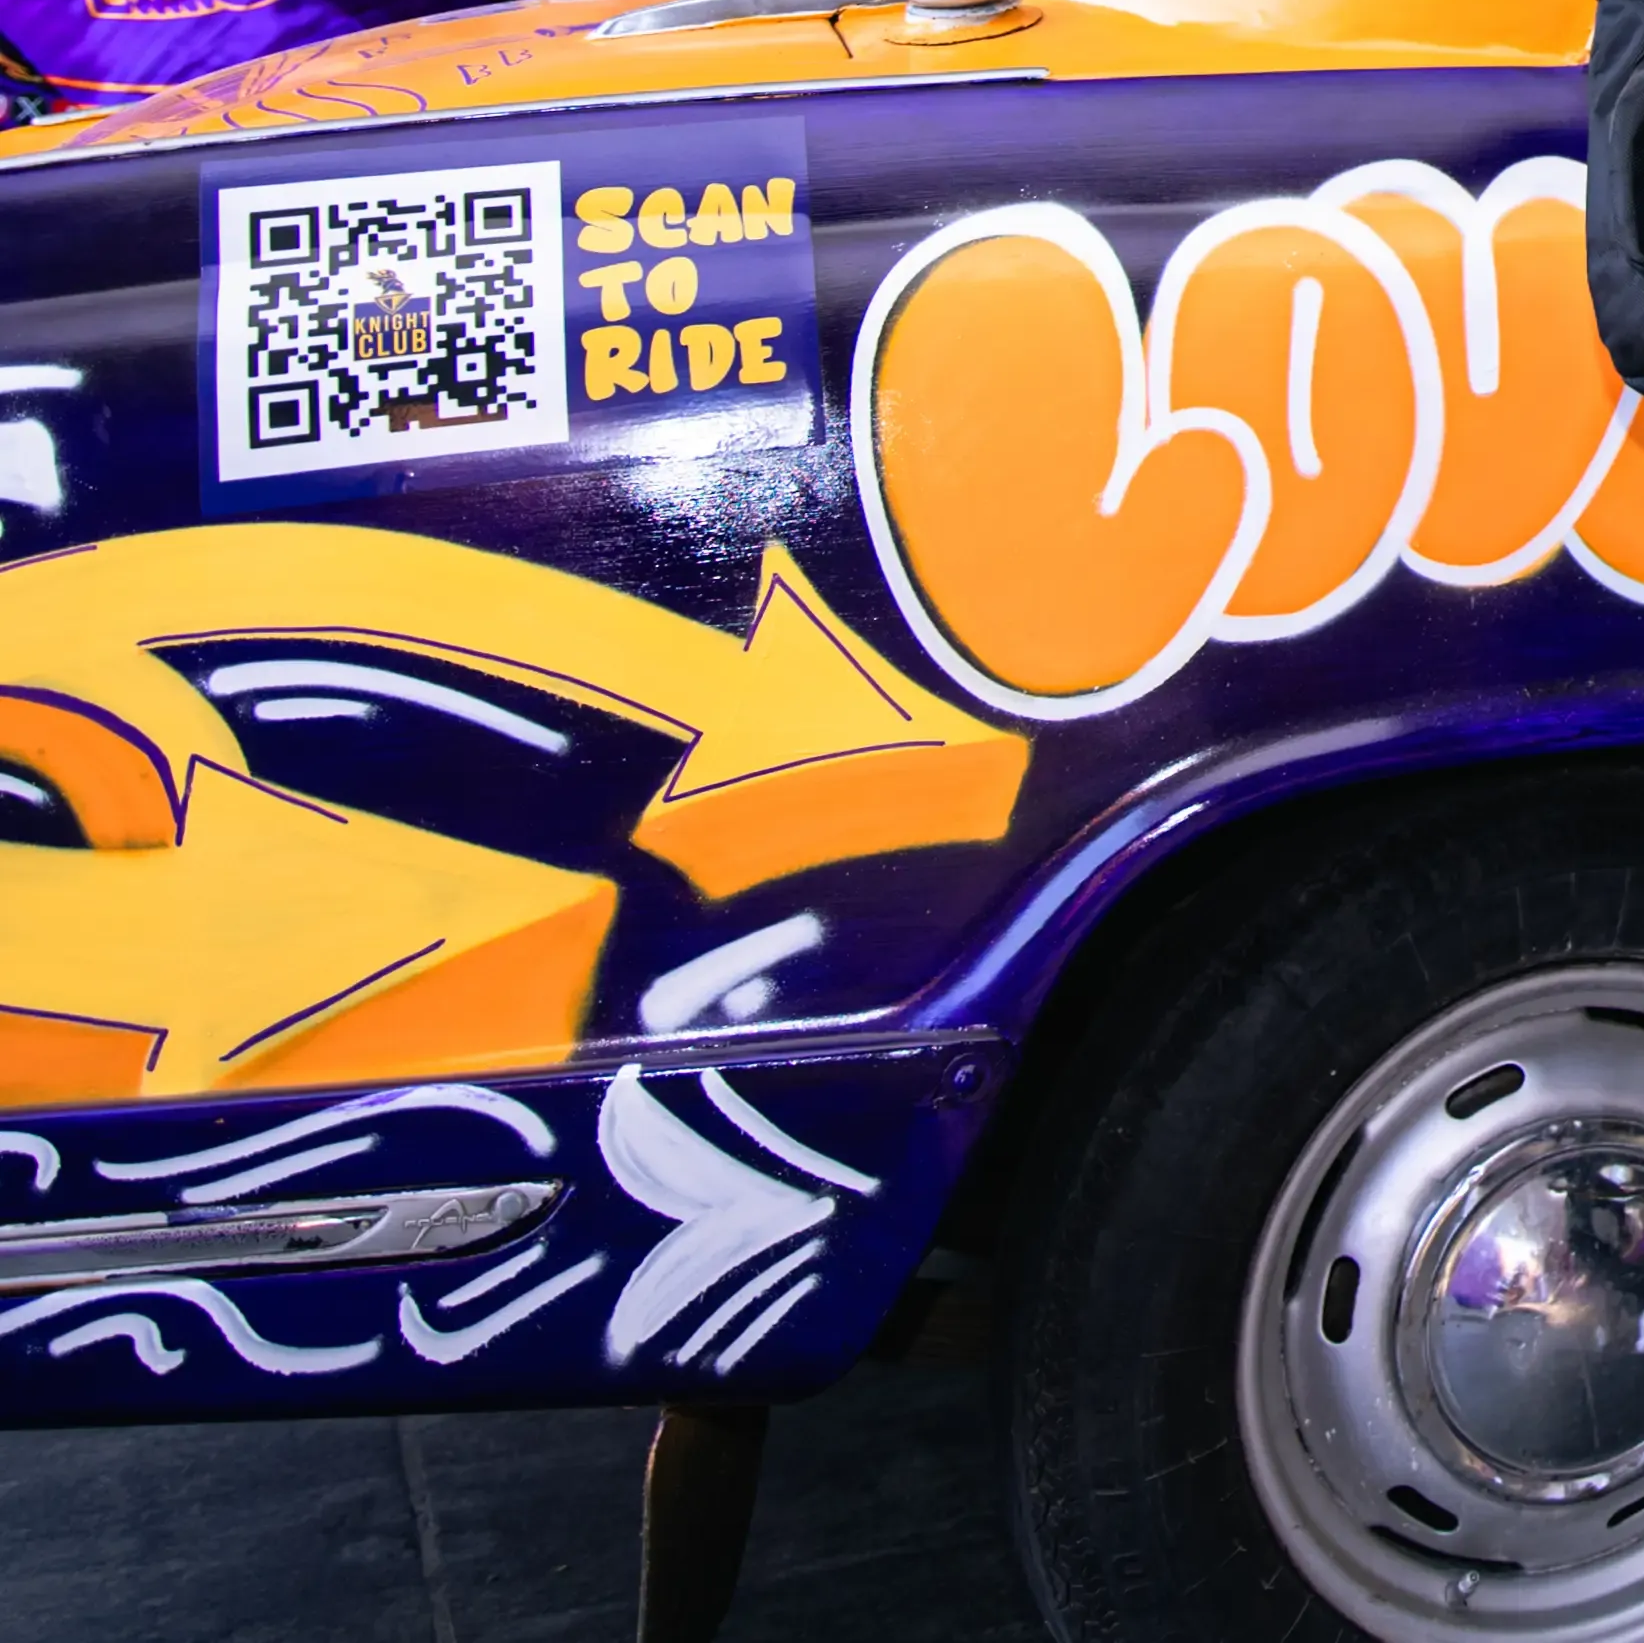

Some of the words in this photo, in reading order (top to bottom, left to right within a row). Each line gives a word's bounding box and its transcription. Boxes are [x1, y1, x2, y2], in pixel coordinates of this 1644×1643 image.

[575, 178, 796, 254] SCAN
[578, 256, 699, 322] TO
[355, 311, 430, 334] KNIGHT
[359, 328, 427, 359] CLUB
[581, 317, 787, 401] RIDE
